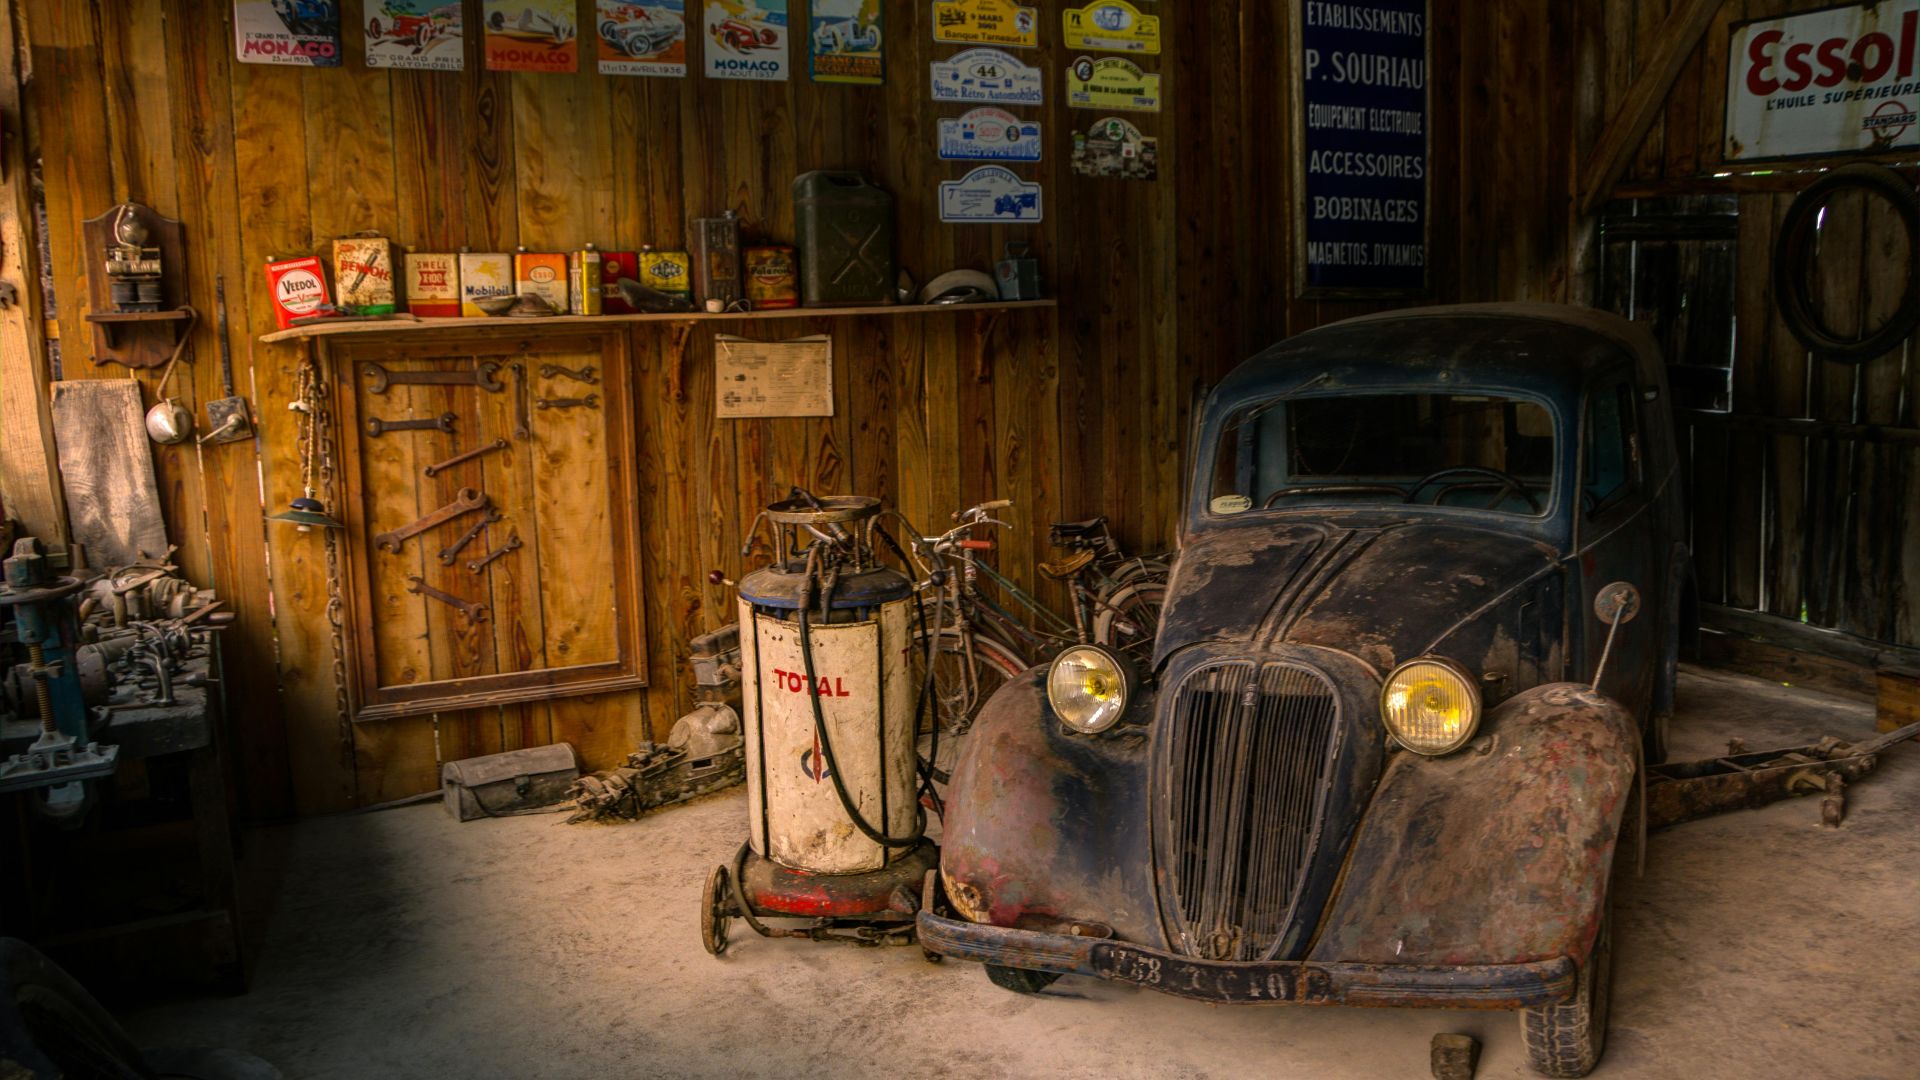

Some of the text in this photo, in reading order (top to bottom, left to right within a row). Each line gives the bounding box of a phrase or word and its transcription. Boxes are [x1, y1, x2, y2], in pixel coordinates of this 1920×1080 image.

[978, 14, 1004, 22] MARS
[1307, 1, 1423, 37] ETABLISSEMENTS
[944, 30, 978, 41] Banque
[243, 39, 336, 59] MONACO
[390, 54, 428, 62] GRAND
[492, 49, 570, 65] MONACO
[714, 59, 780, 72] MONACO
[976, 65, 997, 77] 44
[1305, 48, 1423, 89] P. SOURIAU
[988, 87, 1042, 101] Automobiles
[1766, 95, 1816, 111] L'HUILE
[1863, 114, 1917, 128] STANDARD
[1309, 149, 1424, 180] ACCESSOIRES
[1313, 195, 1419, 223] BOBINAGES
[416, 261, 447, 269] SHELL
[422, 272, 444, 283] X-100
[282, 279, 317, 294] VEEDOL
[466, 286, 510, 296] Mobiloil
